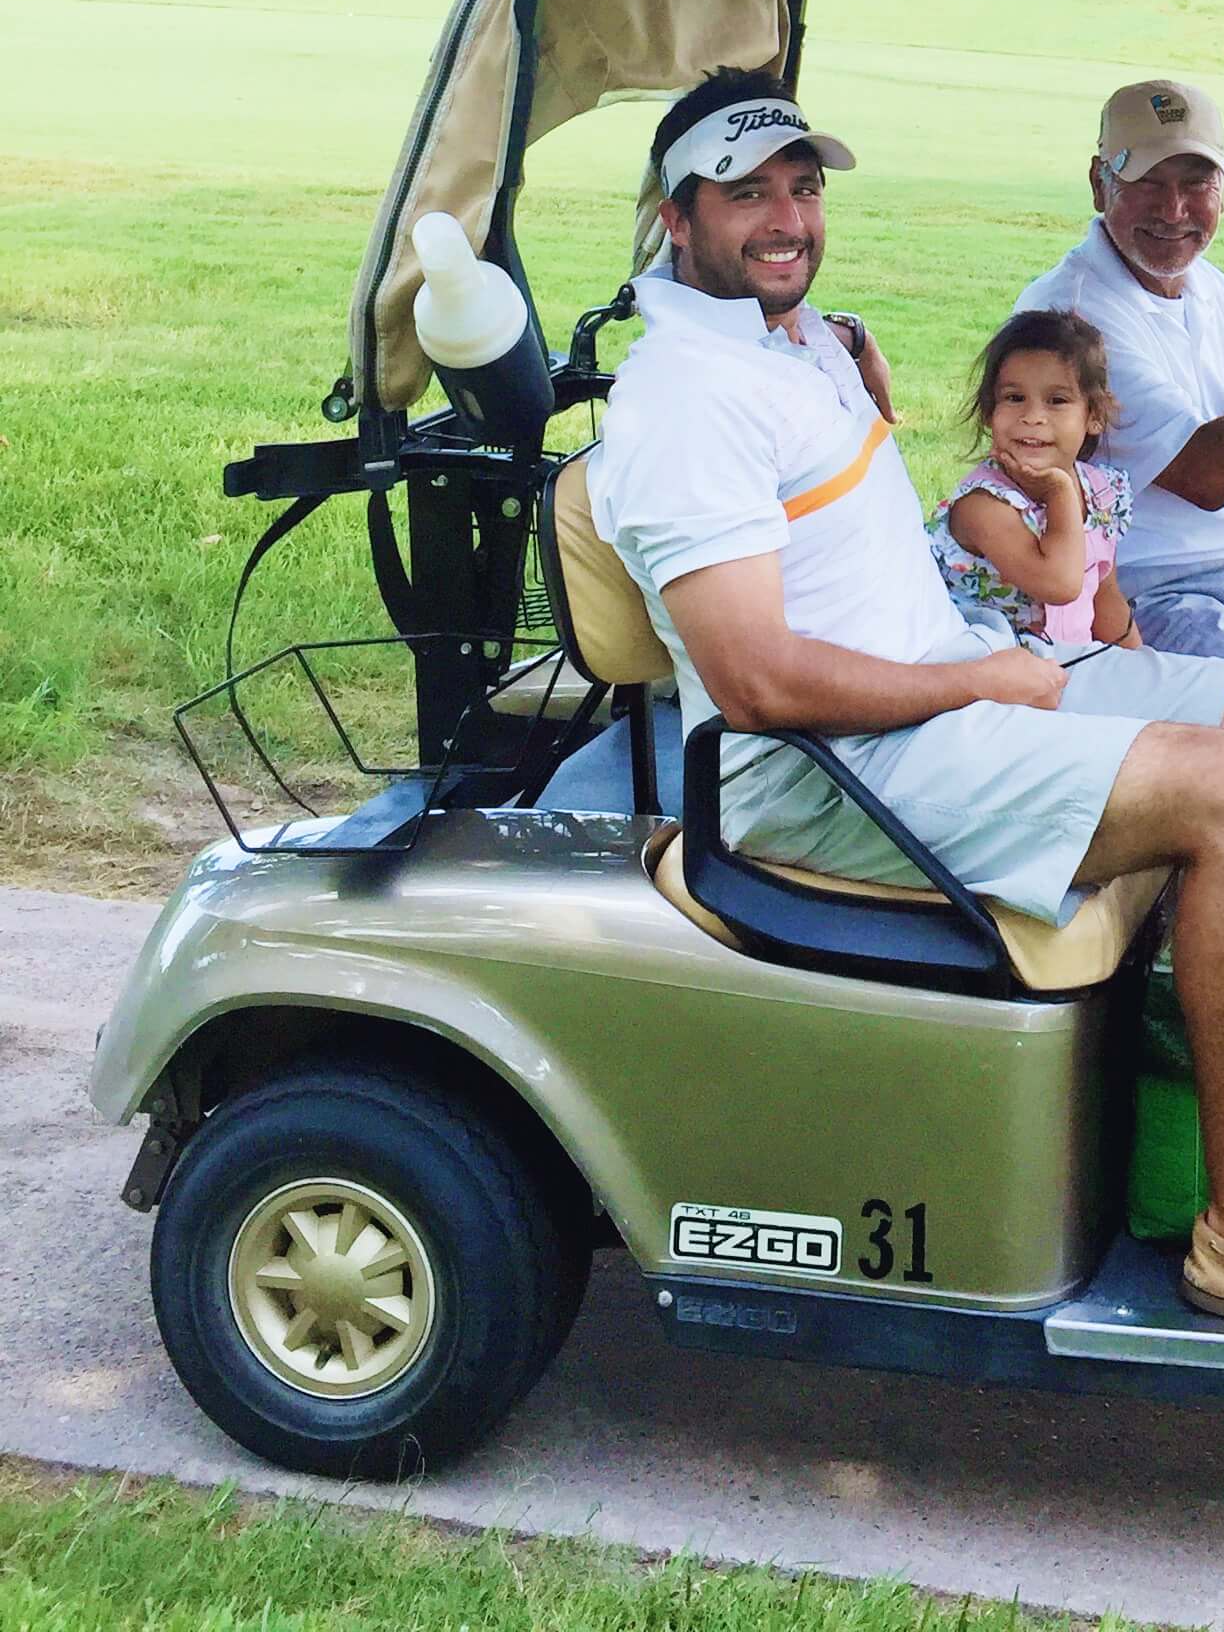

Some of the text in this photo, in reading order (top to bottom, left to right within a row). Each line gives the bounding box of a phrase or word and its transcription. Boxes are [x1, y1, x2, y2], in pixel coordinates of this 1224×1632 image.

[725, 107, 810, 141] Titleis
[681, 1206, 720, 1218] TXT
[858, 1199, 933, 1282] 31
